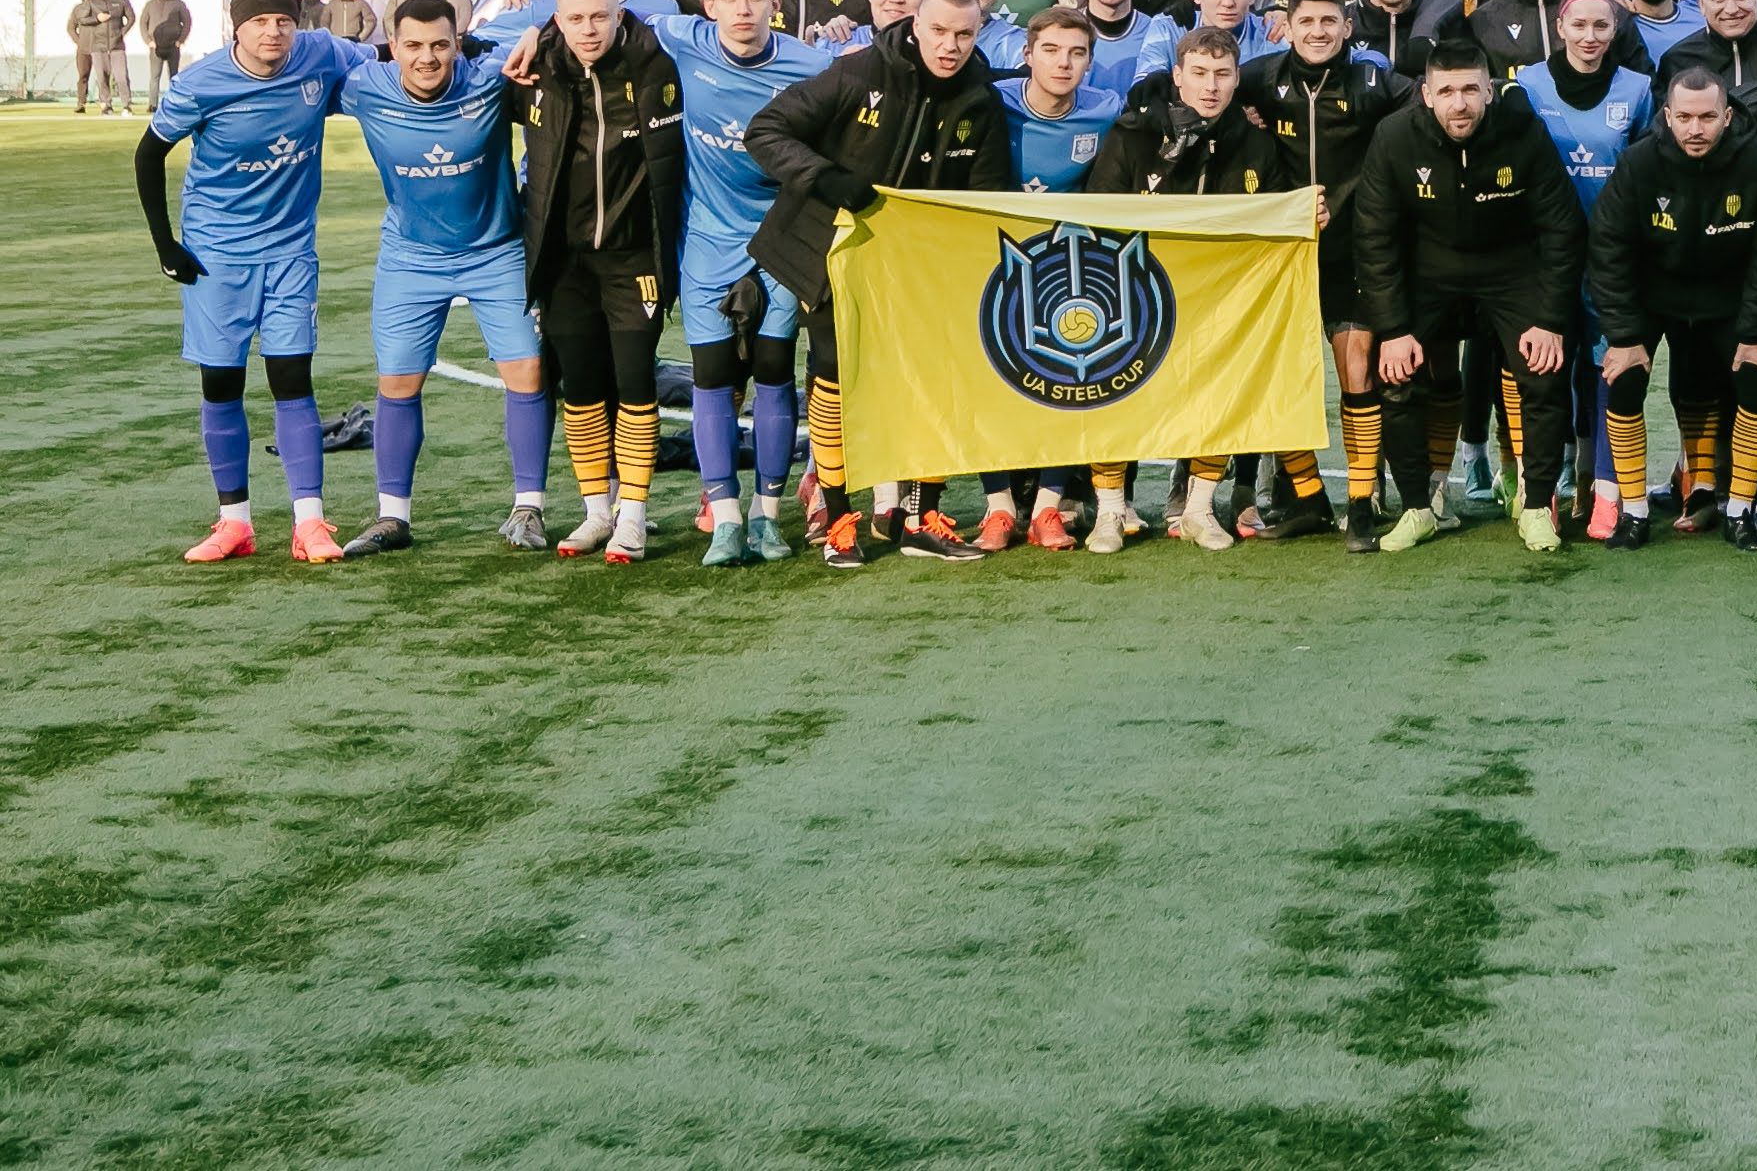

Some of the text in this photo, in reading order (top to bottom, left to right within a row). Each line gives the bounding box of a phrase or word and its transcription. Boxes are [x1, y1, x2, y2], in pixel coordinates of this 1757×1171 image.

[857, 107, 880, 128] I.H.
[395, 153, 486, 178] FAVBET
[1566, 165, 1616, 178] VBET
[1416, 184, 1436, 199] T.I.
[635, 275, 658, 302] 10
[1023, 359, 1146, 401] UA STEEL CUP
